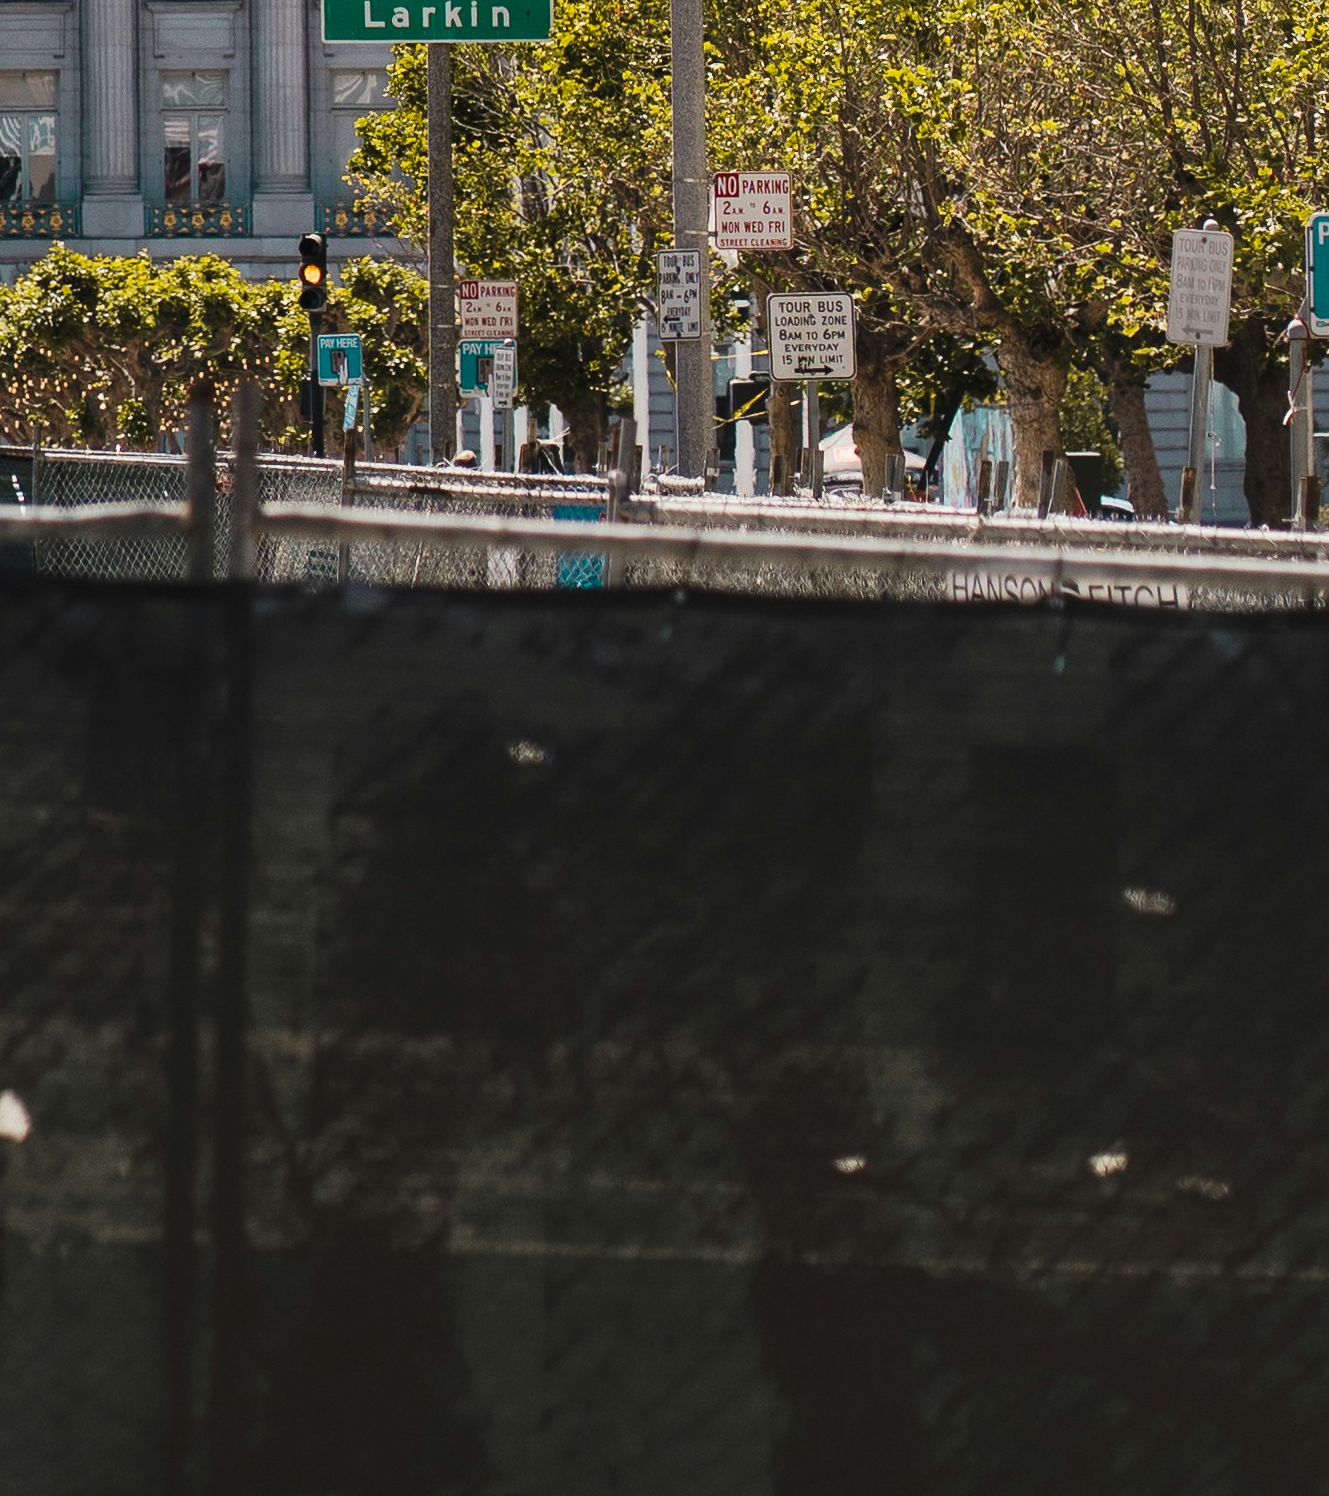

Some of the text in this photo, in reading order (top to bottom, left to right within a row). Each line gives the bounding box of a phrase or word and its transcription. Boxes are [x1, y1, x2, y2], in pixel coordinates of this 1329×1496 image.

[363, 0, 511, 29] Larkin
[717, 176, 789, 195] NO PARKING
[721, 221, 785, 233] MON WED FRI
[720, 238, 748, 247] STREET
[1179, 238, 1229, 256] TOUR BUS
[682, 255, 694, 267] BUS
[1176, 273, 1195, 289] 8AM
[462, 283, 516, 298] NO PARKING
[1181, 292, 1220, 306] EVERYDAY
[778, 300, 843, 313] TOUR BUS
[464, 317, 513, 326] MON WED FRI
[775, 315, 847, 326] LOADING ZONE
[779, 329, 845, 341] 8AM TO 6PM
[320, 337, 359, 348] PAY HERE
[462, 343, 482, 354] PAY
[784, 343, 839, 352] EVERYDAY
[781, 354, 844, 365] 15 MIN LIMIT
